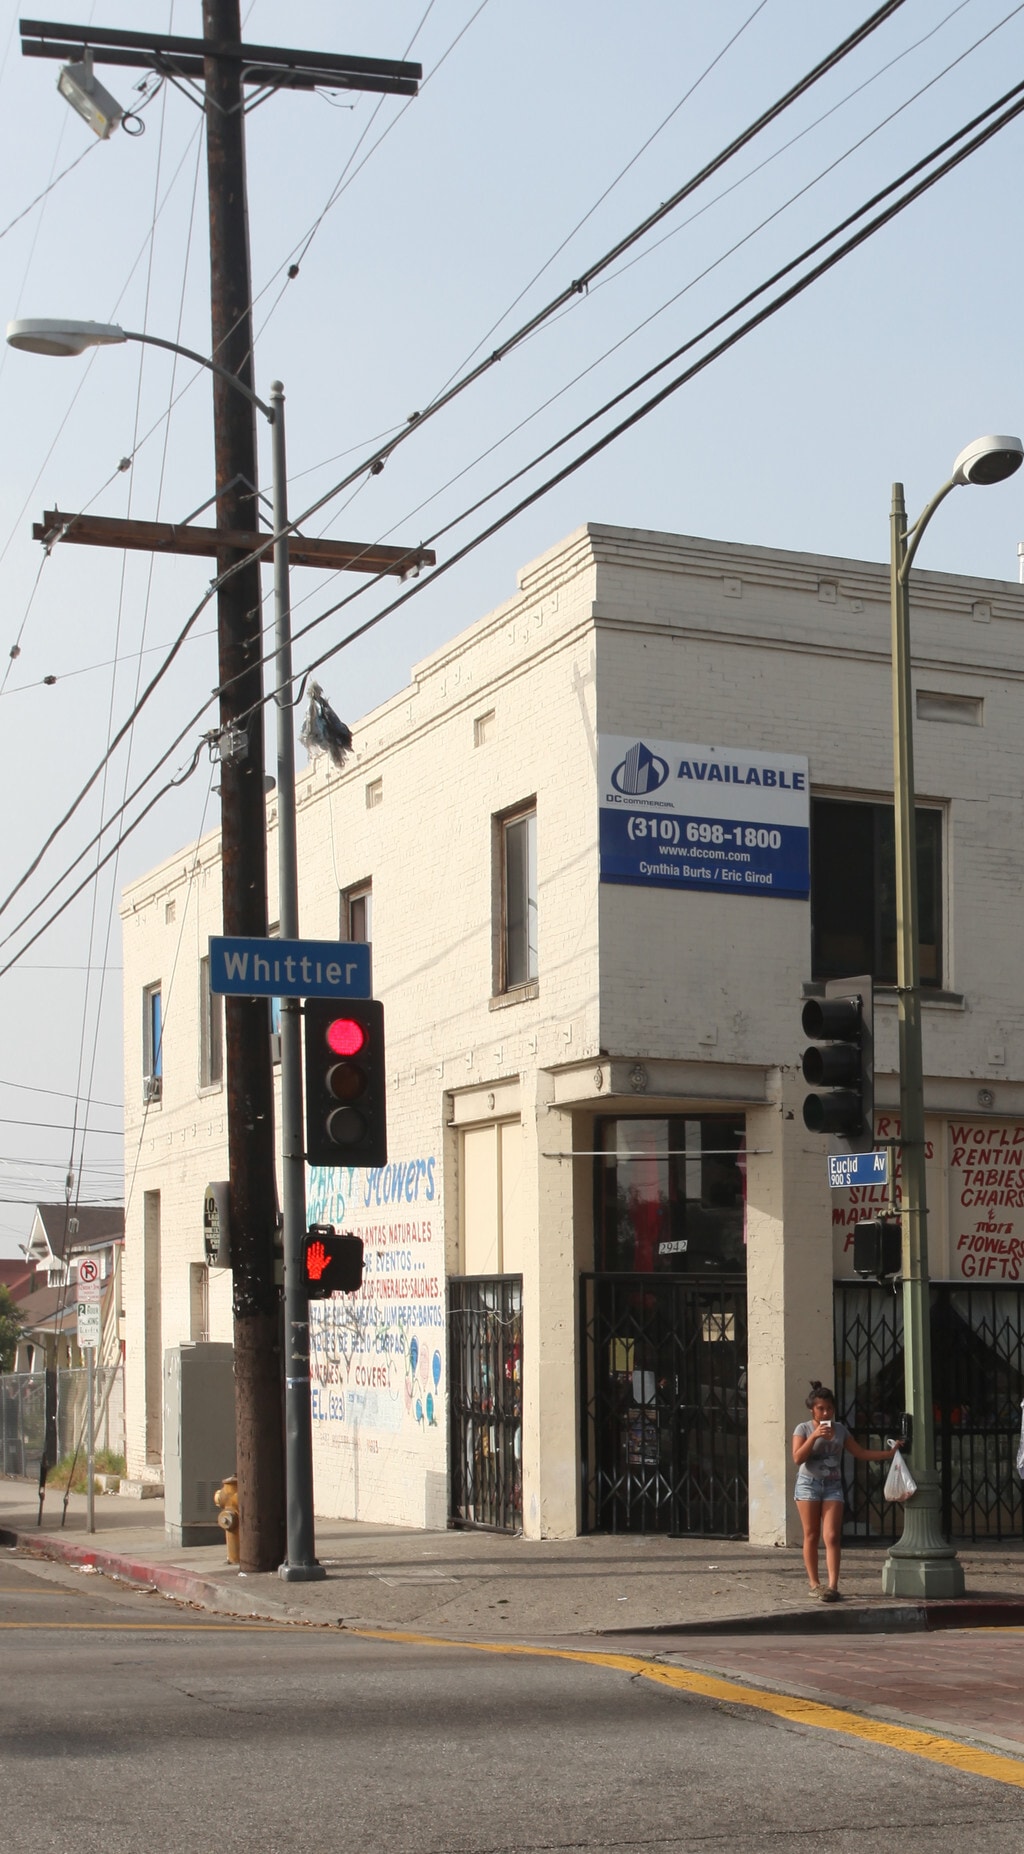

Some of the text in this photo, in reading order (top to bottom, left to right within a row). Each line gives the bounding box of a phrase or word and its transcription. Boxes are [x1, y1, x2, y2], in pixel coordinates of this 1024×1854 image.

[677, 760, 806, 791] AVAILABLE
[606, 793, 622, 804] DC
[627, 816, 782, 850] (310) 698-1800
[658, 844, 751, 863] www.dccom.com
[639, 861, 680, 877] Cynthia
[682, 864, 712, 880] Burts
[721, 868, 742, 882] Eric
[744, 871, 773, 885] Girod
[223, 951, 358, 985] Whittier
[830, 1154, 885, 1174] Euclid Av
[830, 1173, 851, 1185] 900 S
[388, 1221, 432, 1243] NATURALES
[974, 1221, 1014, 1234] more
[660, 1241, 688, 1254] 2942
[961, 1254, 1022, 1280] GIFTS
